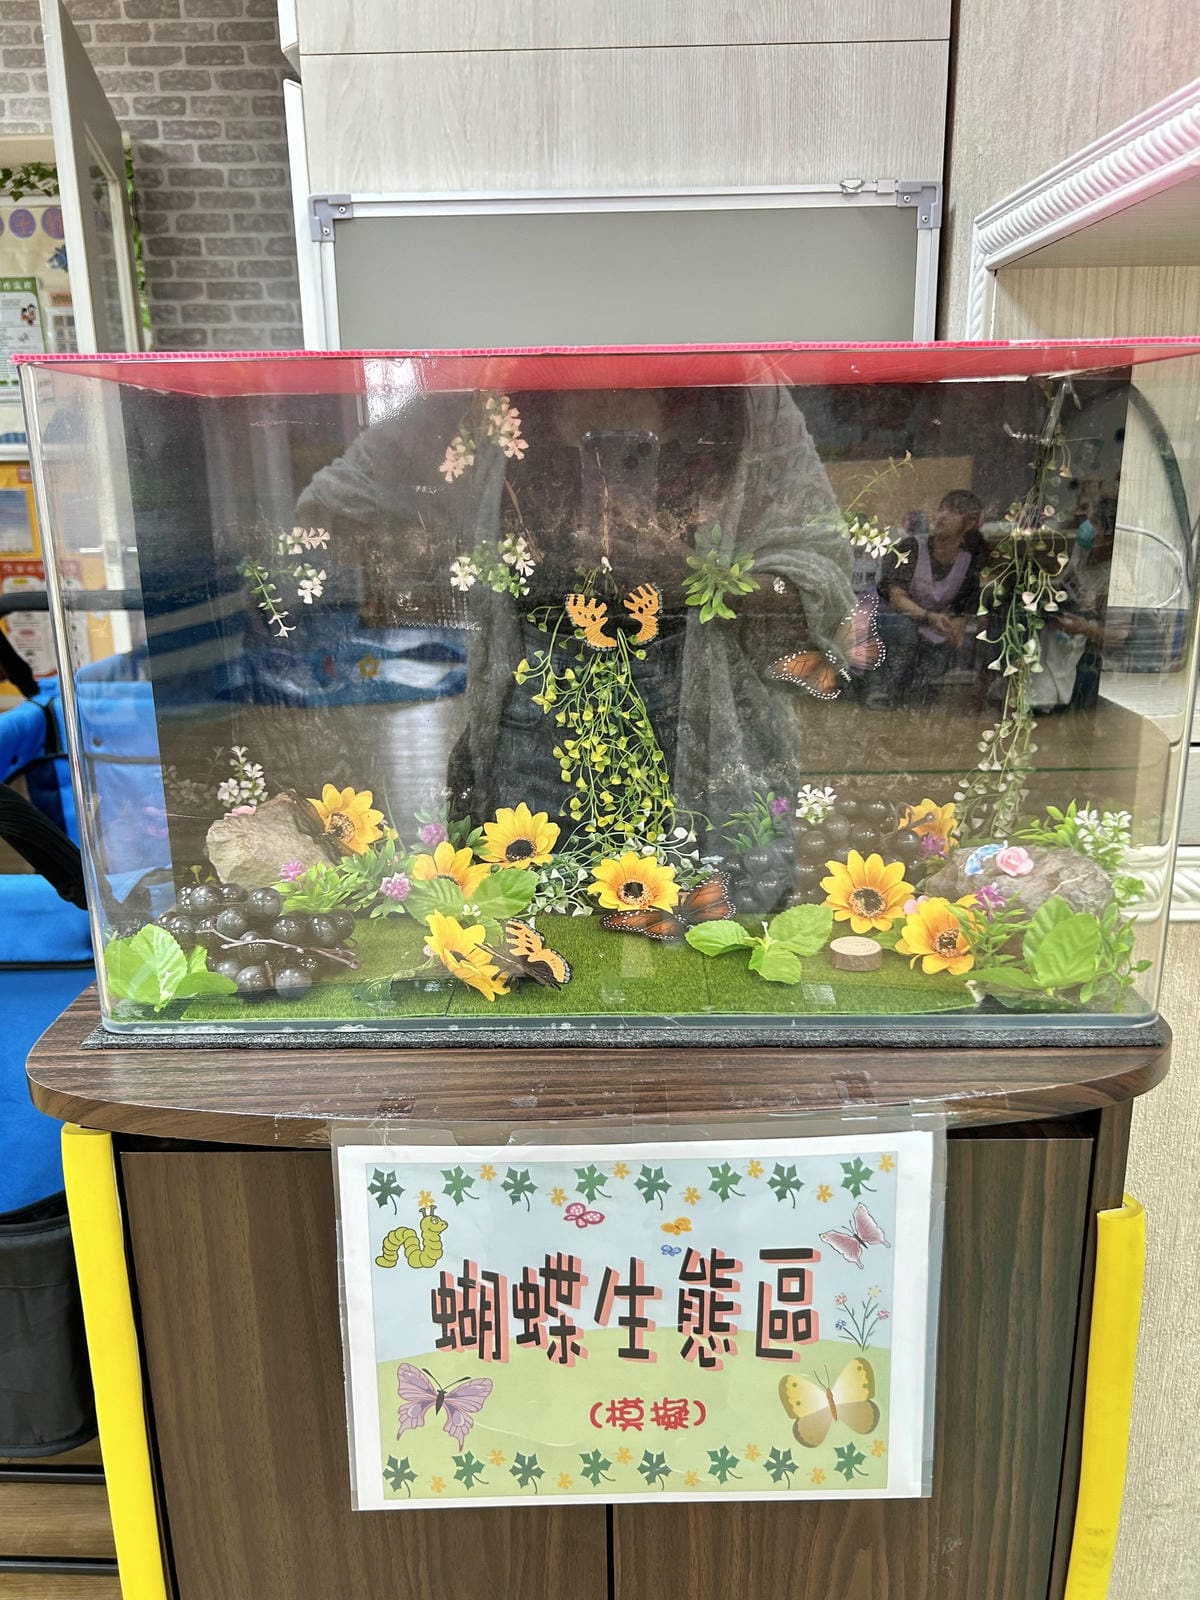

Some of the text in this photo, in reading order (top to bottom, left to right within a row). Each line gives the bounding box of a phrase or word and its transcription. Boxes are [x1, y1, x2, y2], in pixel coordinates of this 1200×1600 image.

[430, 1246, 821, 1370] 蝴蝶生態區
